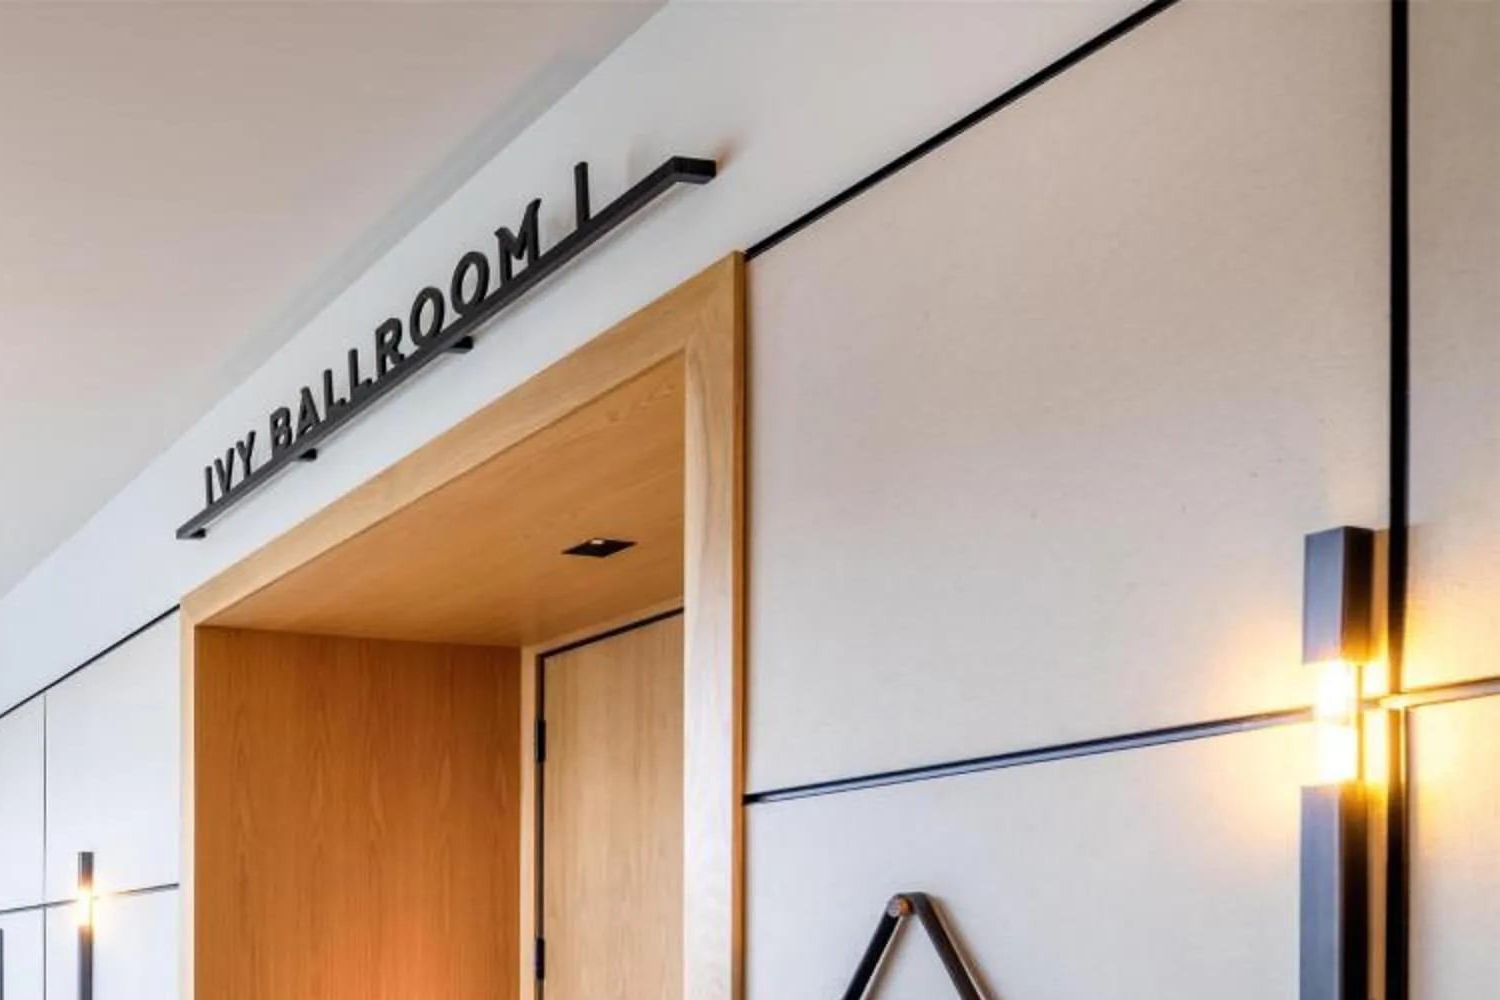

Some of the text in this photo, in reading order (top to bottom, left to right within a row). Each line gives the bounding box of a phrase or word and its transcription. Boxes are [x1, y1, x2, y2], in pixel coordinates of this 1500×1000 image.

[205, 161, 591, 508] IVY BALLROOM I
